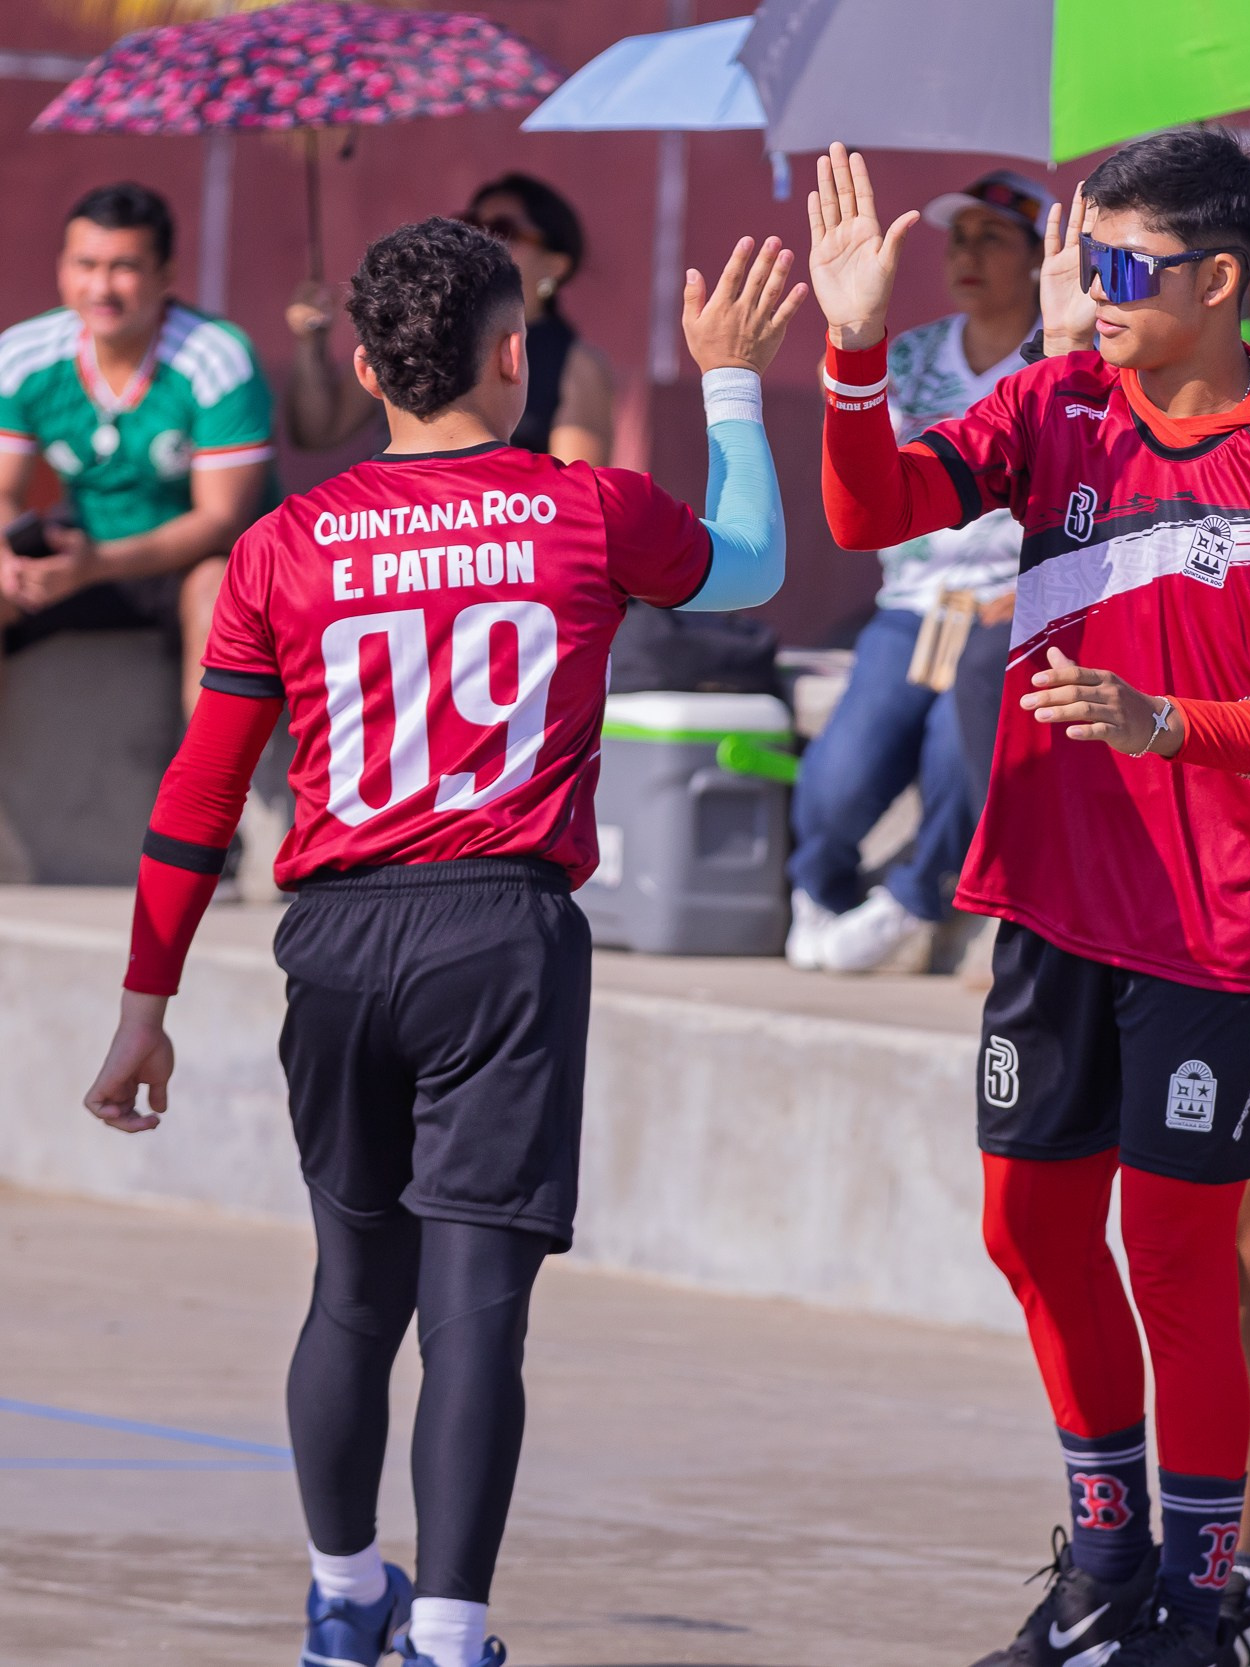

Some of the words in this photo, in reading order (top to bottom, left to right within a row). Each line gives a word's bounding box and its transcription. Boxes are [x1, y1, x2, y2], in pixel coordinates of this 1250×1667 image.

[863, 393, 885, 410] HOME
[314, 499, 478, 546] QUINTANA
[482, 489, 557, 526] ROO
[332, 557, 364, 602] E.
[372, 540, 536, 597] PATRON
[1182, 568, 1210, 584] QUINTANA
[1210, 578, 1223, 588] ROO
[321, 600, 558, 828] 09
[1072, 1472, 1134, 1531] B
